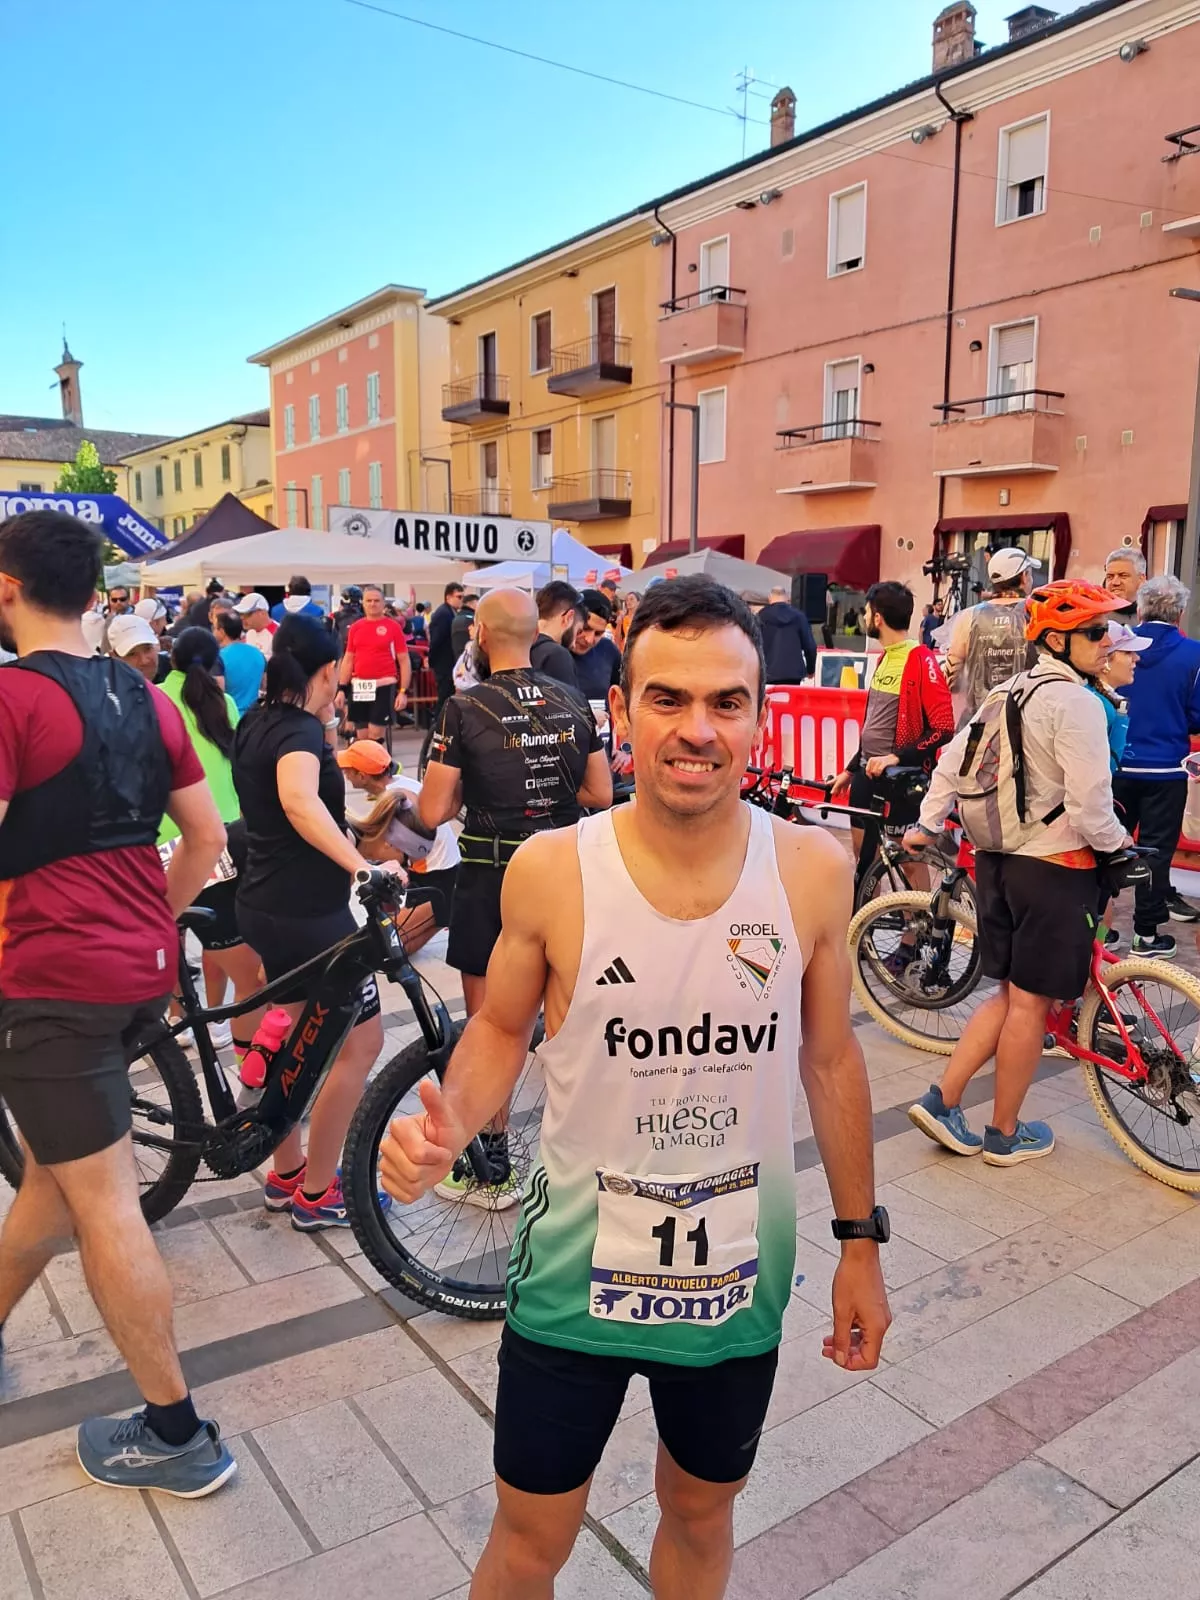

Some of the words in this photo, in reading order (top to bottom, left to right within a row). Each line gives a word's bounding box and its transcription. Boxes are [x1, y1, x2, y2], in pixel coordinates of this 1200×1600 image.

[0, 496, 105, 524] oma
[394, 518, 498, 554] ARRIVO
[995, 616, 1010, 625] ITA
[359, 682, 373, 690] 169
[517, 686, 543, 699] ITA
[730, 924, 778, 935] OROEL
[727, 955, 746, 988] CLUB
[605, 1012, 778, 1059] fondavi
[681, 1067, 697, 1076] gas
[703, 1062, 753, 1073] calefacción
[695, 1165, 754, 1191] ROMAGNA
[652, 1216, 709, 1267] 11
[612, 1272, 658, 1287] ALBERTO
[661, 1277, 708, 1290] PUYUELO
[711, 1269, 740, 1287] PARDO
[438, 1292, 489, 1310] PATROL
[630, 1284, 750, 1321] Joma
